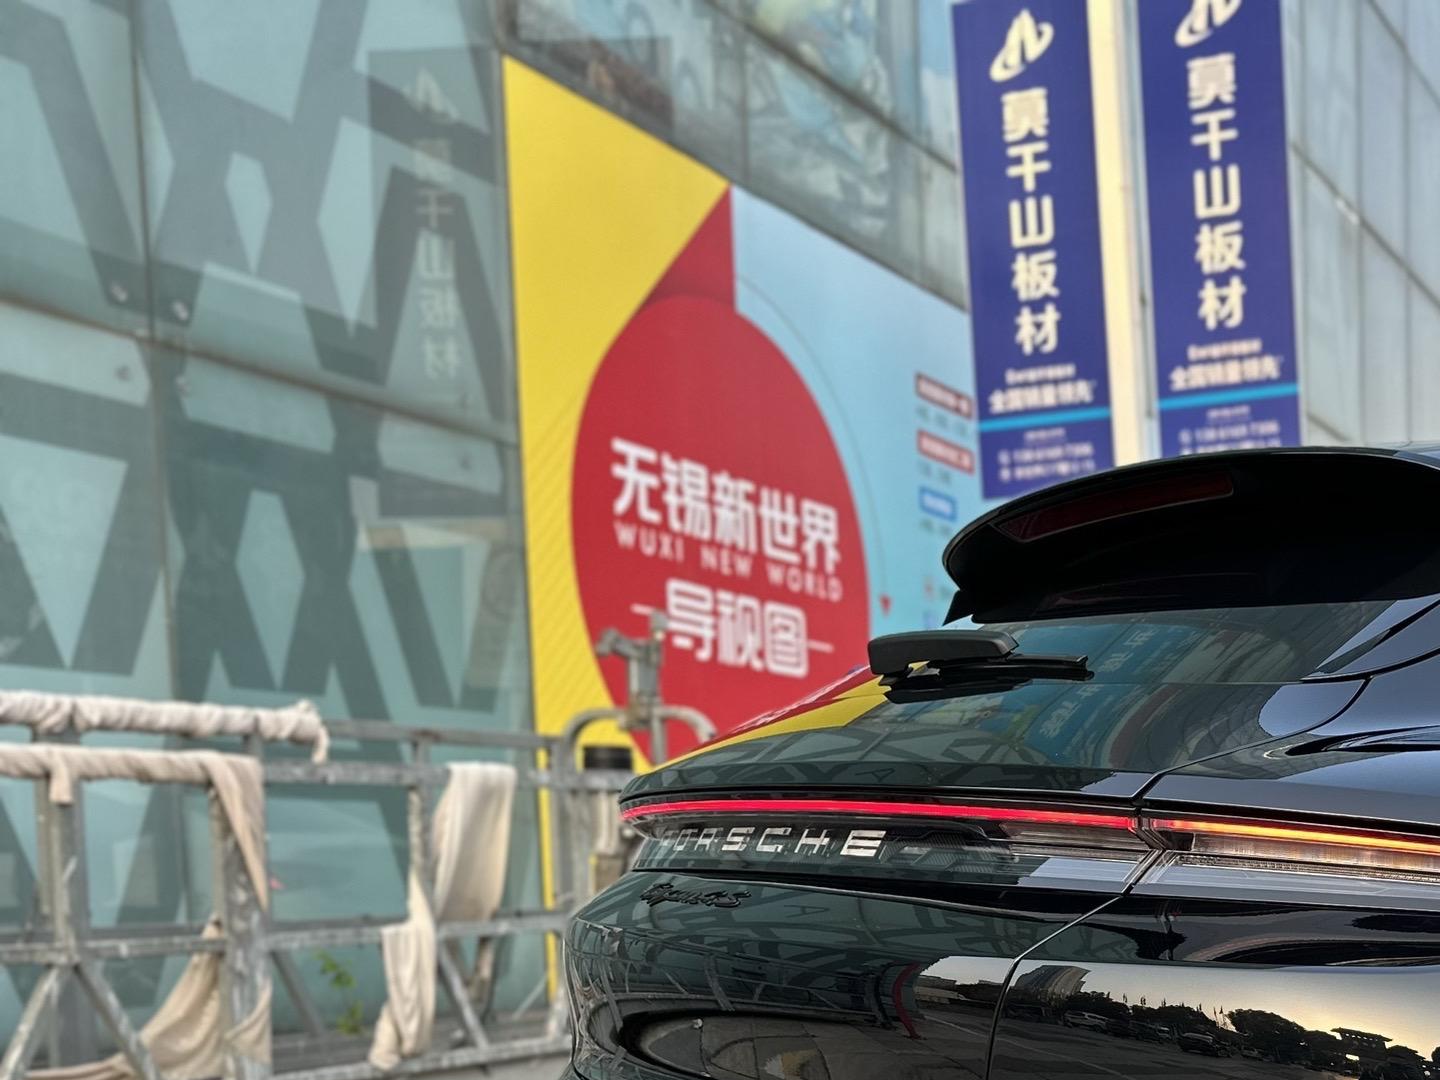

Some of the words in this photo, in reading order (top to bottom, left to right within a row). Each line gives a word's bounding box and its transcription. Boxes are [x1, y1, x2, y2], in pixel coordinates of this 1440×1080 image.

[1001, 87, 1060, 356] 莫干山板材
[1186, 53, 1246, 331] 莫干山板材
[610, 436, 841, 575] 无锡新世界
[612, 519, 685, 564] WUXI
[700, 544, 754, 579] NEW
[765, 561, 843, 603] WORLD
[665, 577, 809, 679] 导视图
